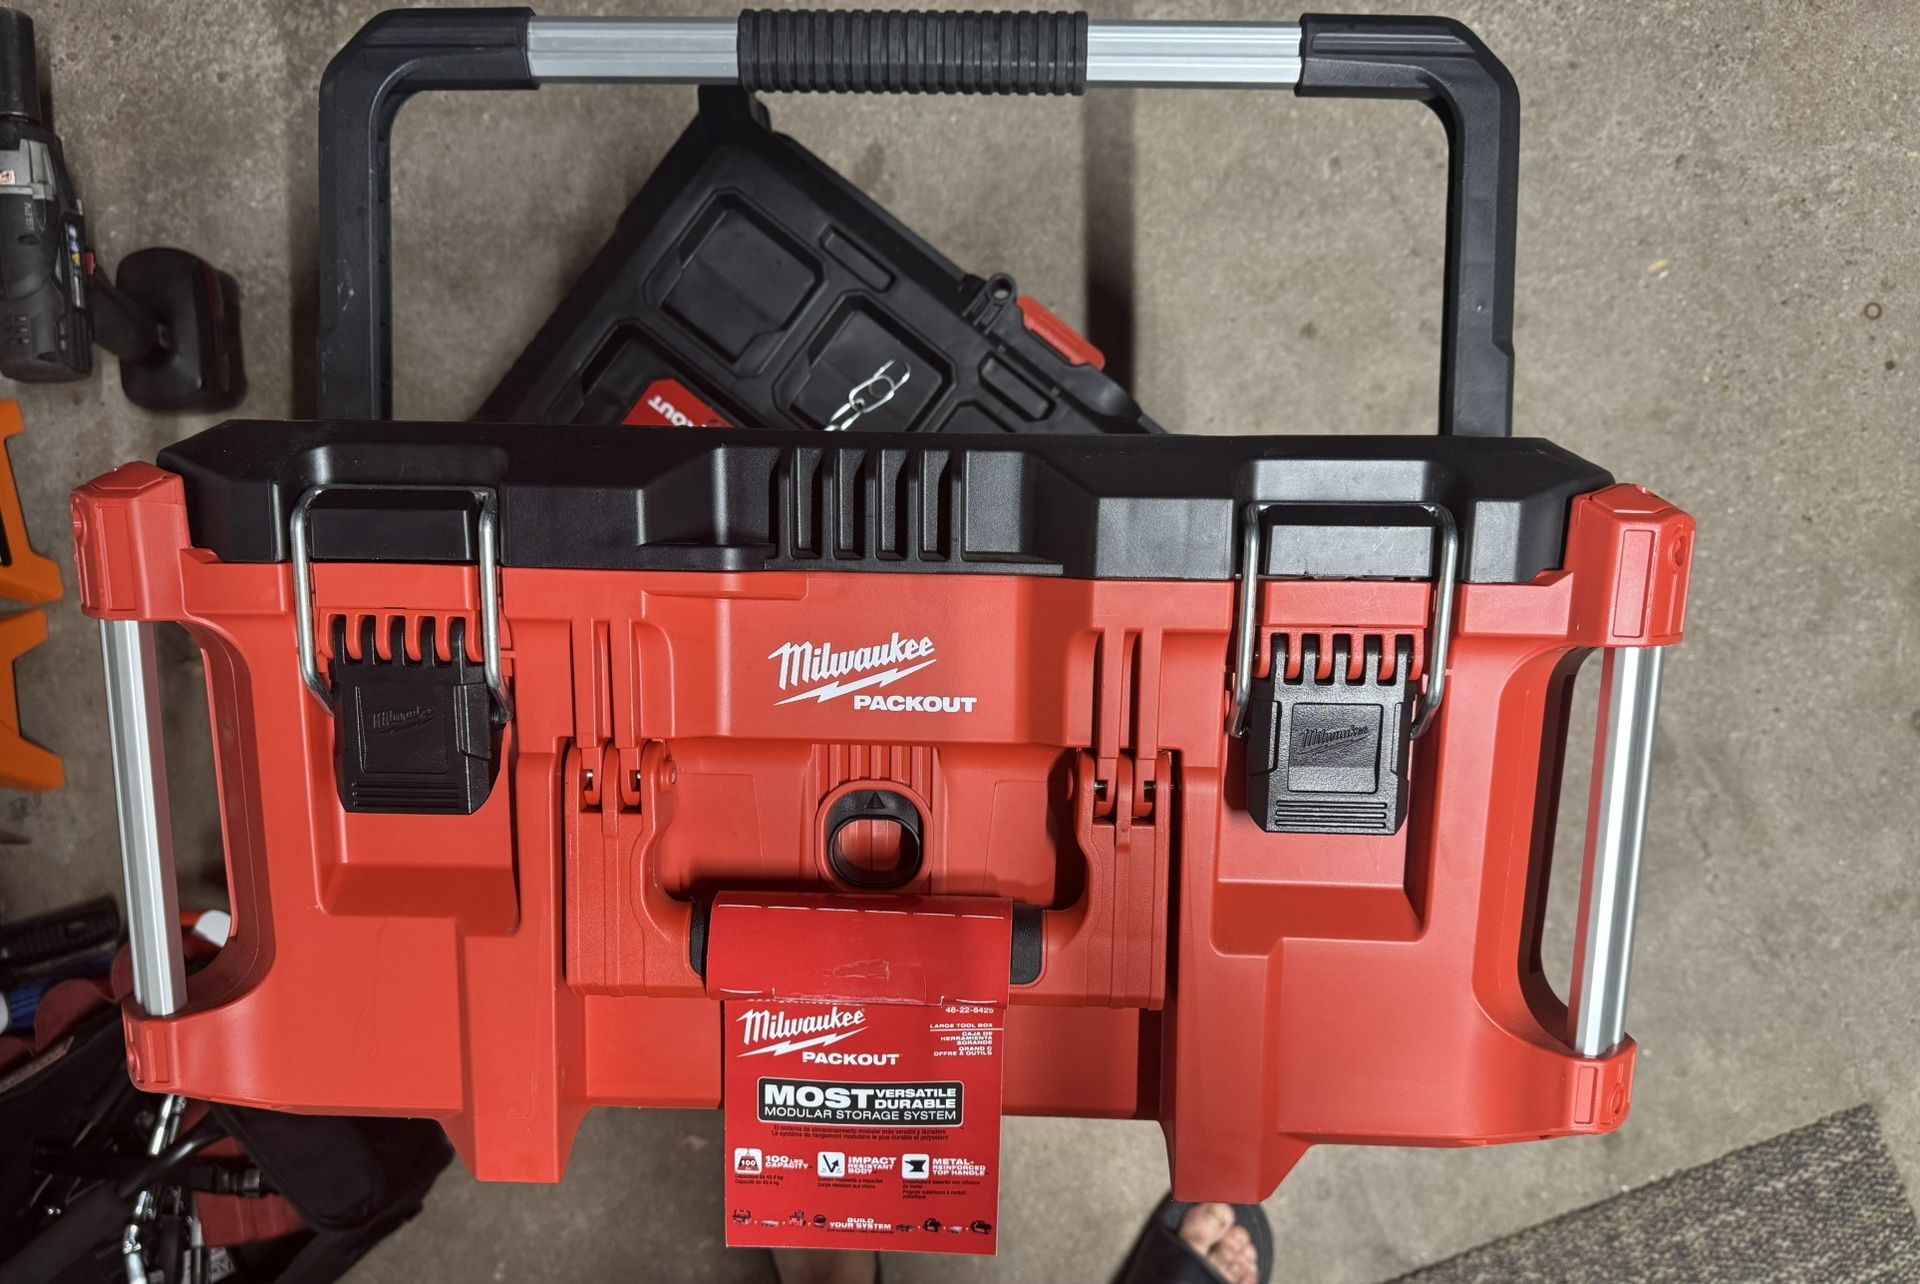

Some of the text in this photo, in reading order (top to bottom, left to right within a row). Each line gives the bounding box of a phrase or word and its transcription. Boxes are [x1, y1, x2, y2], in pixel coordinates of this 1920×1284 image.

[767, 631, 935, 691] Milwaukee
[854, 695, 978, 713] PACKOUT
[1299, 724, 1369, 748] Milwaukee
[736, 1006, 866, 1046] Milwaukee
[802, 1051, 900, 1066] PACKOUT
[764, 1084, 957, 1109] MOST VERSATILE
[874, 1099, 956, 1110] DURABLE
[764, 1106, 956, 1120] MODULAR STORAGE SYSTEM
